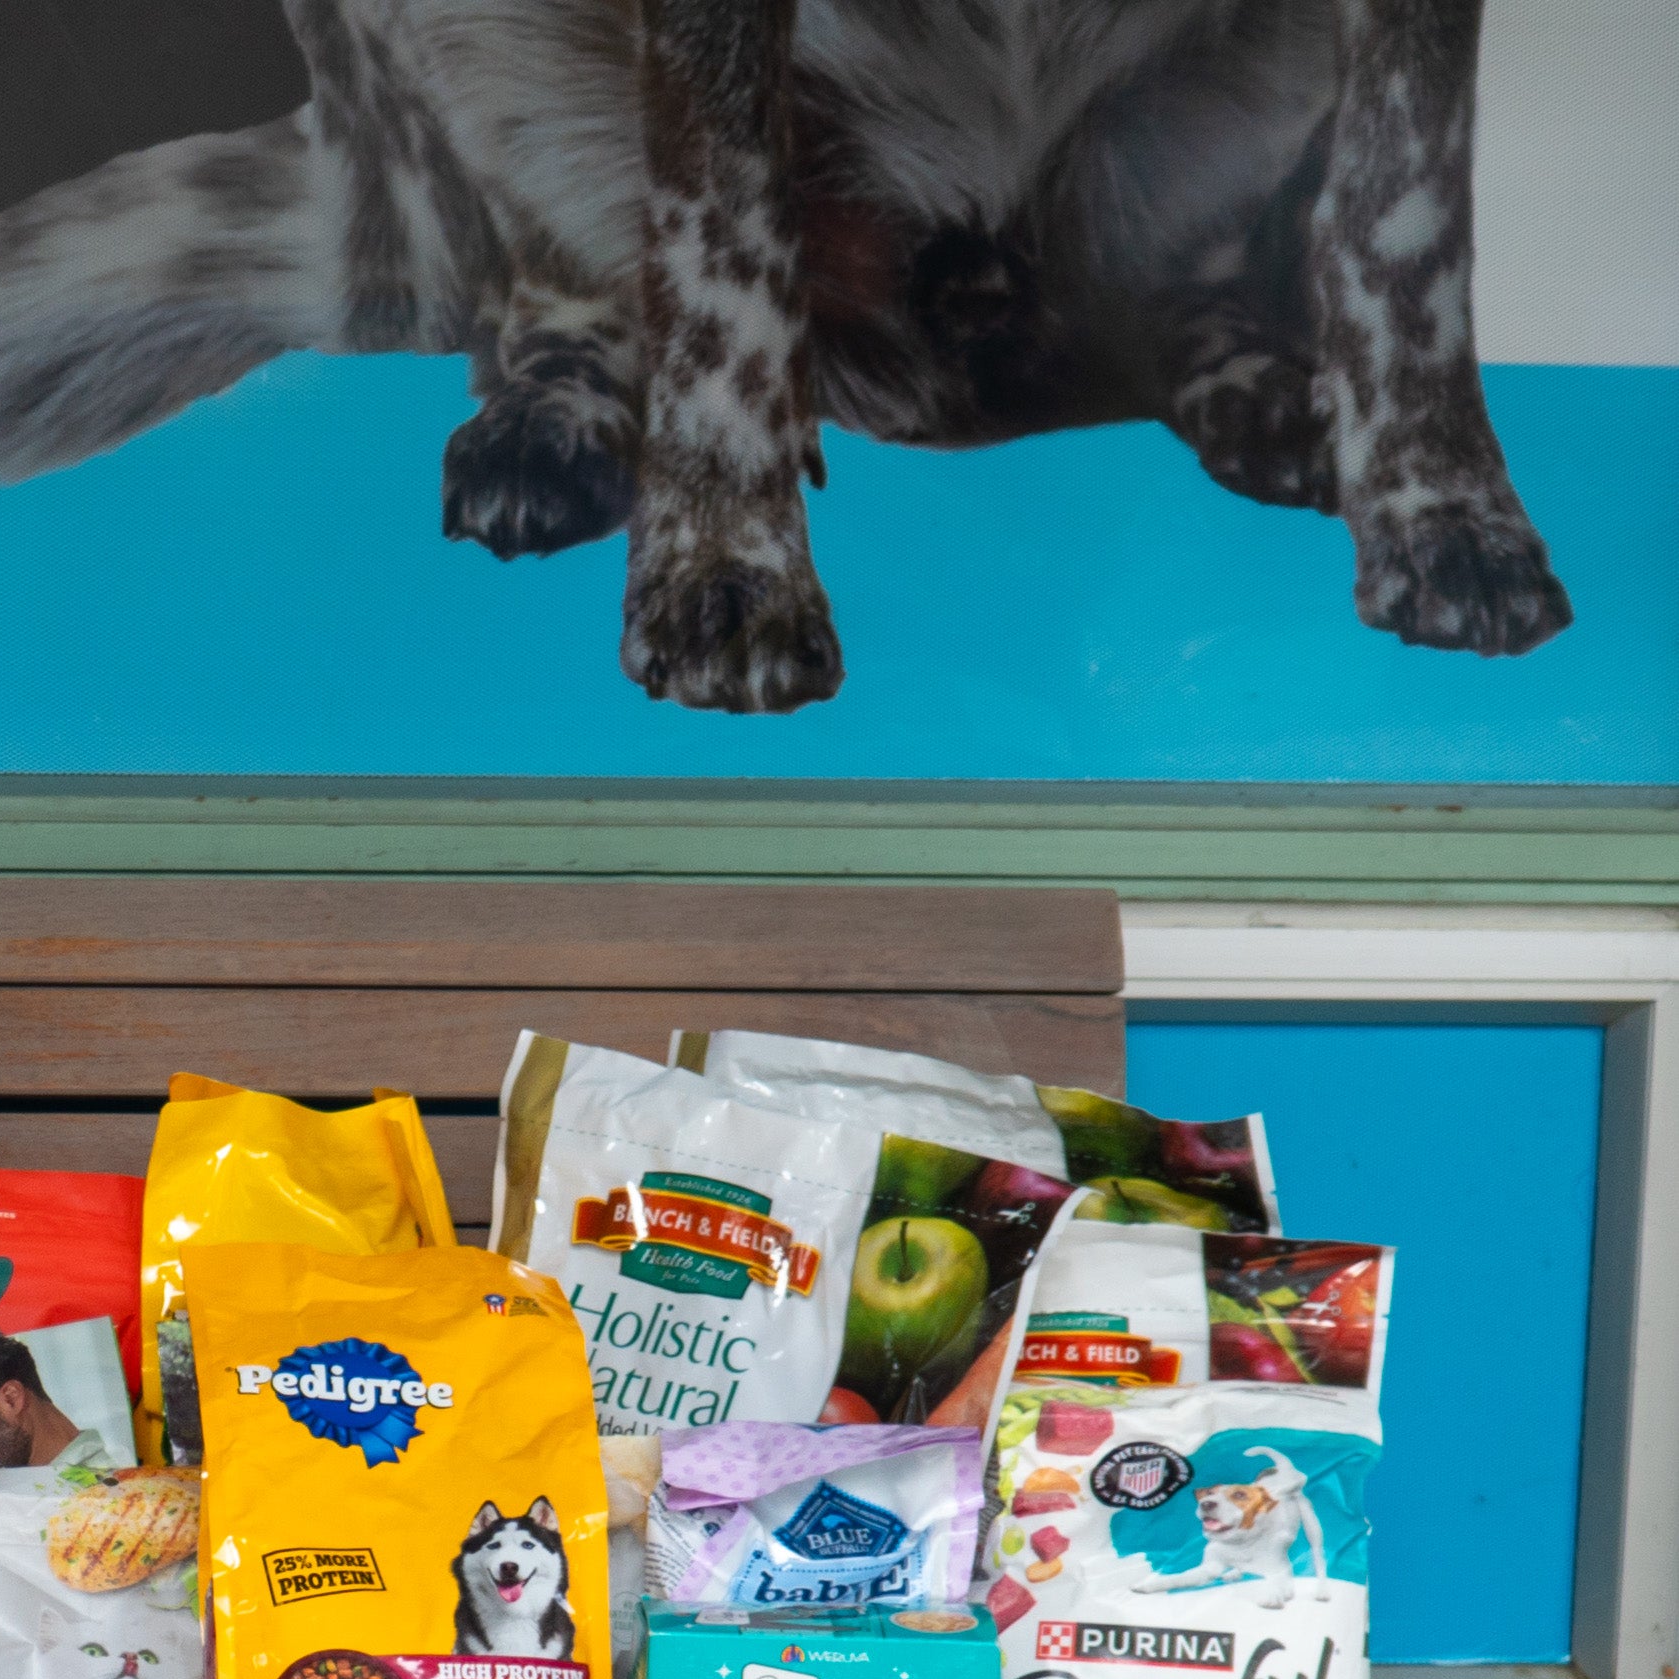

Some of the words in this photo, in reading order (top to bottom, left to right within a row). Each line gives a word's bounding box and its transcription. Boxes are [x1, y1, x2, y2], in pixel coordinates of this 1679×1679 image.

[570, 1283, 757, 1374] Holistic
[235, 1364, 454, 1410] Pedigree
[807, 1527, 872, 1550] BLUE
[273, 1553, 313, 1574] 25%
[316, 1554, 369, 1568] MORE
[278, 1570, 373, 1596] PROTEIN
[1082, 1628, 1226, 1663] PURINA
